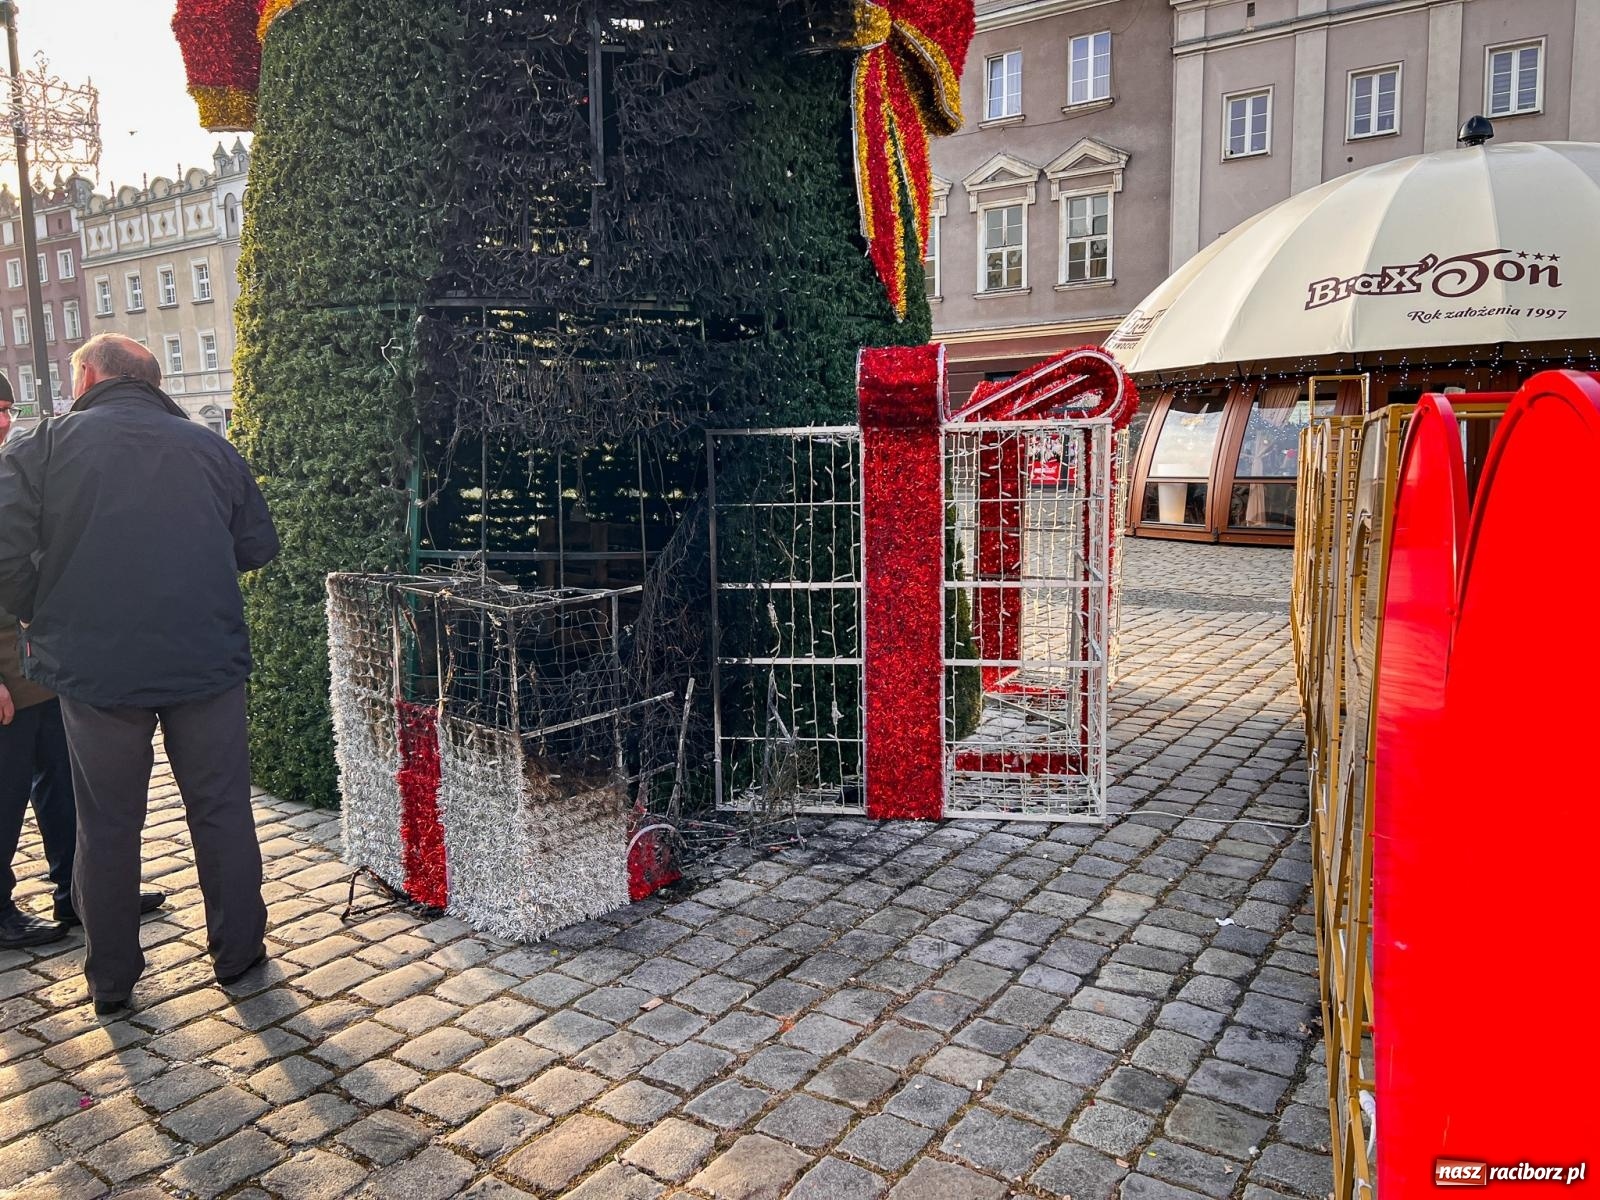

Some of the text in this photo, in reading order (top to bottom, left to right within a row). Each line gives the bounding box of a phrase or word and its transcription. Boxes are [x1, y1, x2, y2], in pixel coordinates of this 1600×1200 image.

[1407, 304, 1568, 324] Rok założenia 1997
